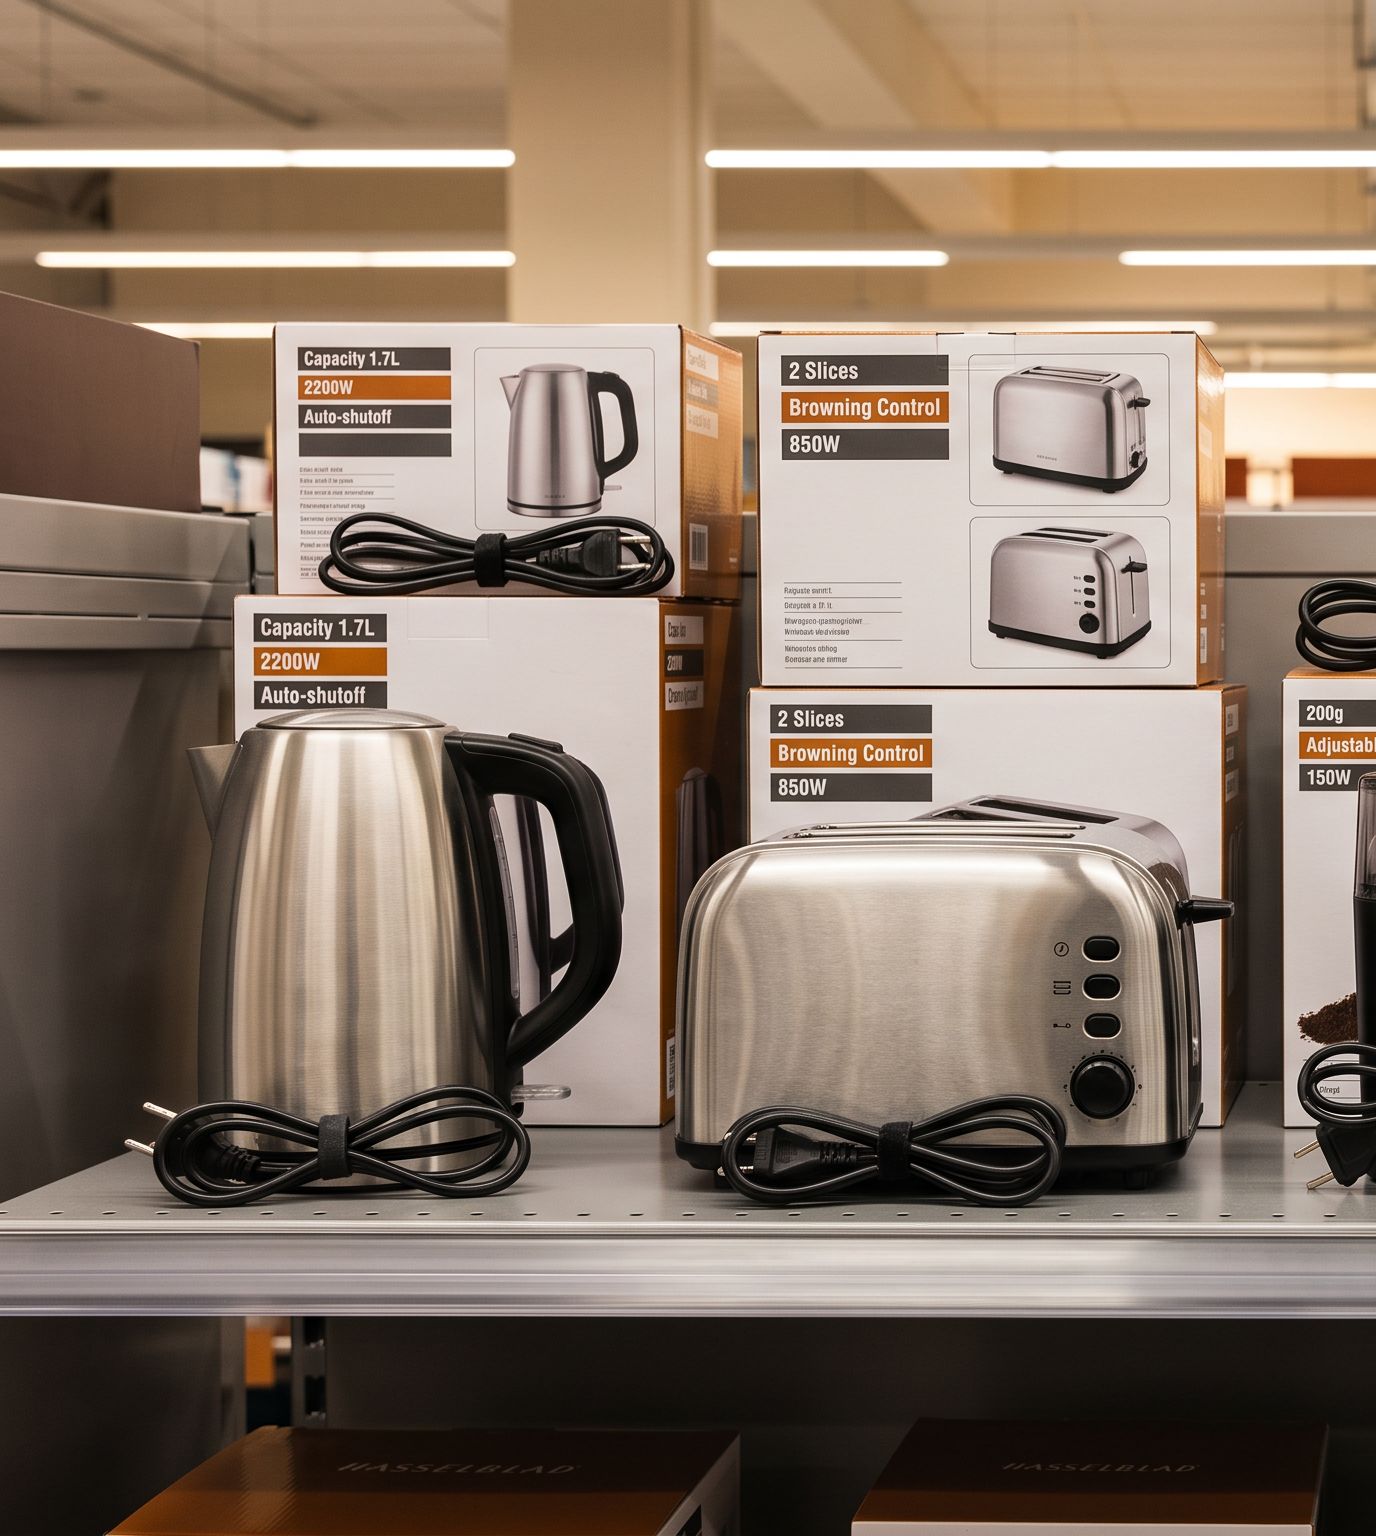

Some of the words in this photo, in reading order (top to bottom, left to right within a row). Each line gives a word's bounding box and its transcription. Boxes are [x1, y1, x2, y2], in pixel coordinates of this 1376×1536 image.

[304, 350, 366, 369] Capacity
[369, 351, 400, 366] 1.7L
[789, 361, 800, 379] 2
[805, 361, 859, 380] Slices
[304, 379, 353, 395] 2200W
[303, 408, 392, 424] Auto-shutoff
[789, 398, 872, 420] Browning
[877, 397, 940, 417] Control
[789, 434, 840, 453] 850W
[261, 617, 333, 640] Capacity
[338, 618, 375, 636] 1.7L
[260, 652, 320, 671] 2200W
[260, 686, 366, 705] Auto-shutoff
[777, 710, 788, 727] 2
[793, 710, 844, 728] Slices
[1306, 704, 1344, 724] 200g
[778, 744, 857, 766] Browning
[863, 743, 924, 762] Control
[778, 778, 827, 796] 850W
[1307, 769, 1351, 786] 150W
[337, 1462, 576, 1475] HASSELBLAD
[1001, 1462, 1196, 1473] HASSELBLAD
